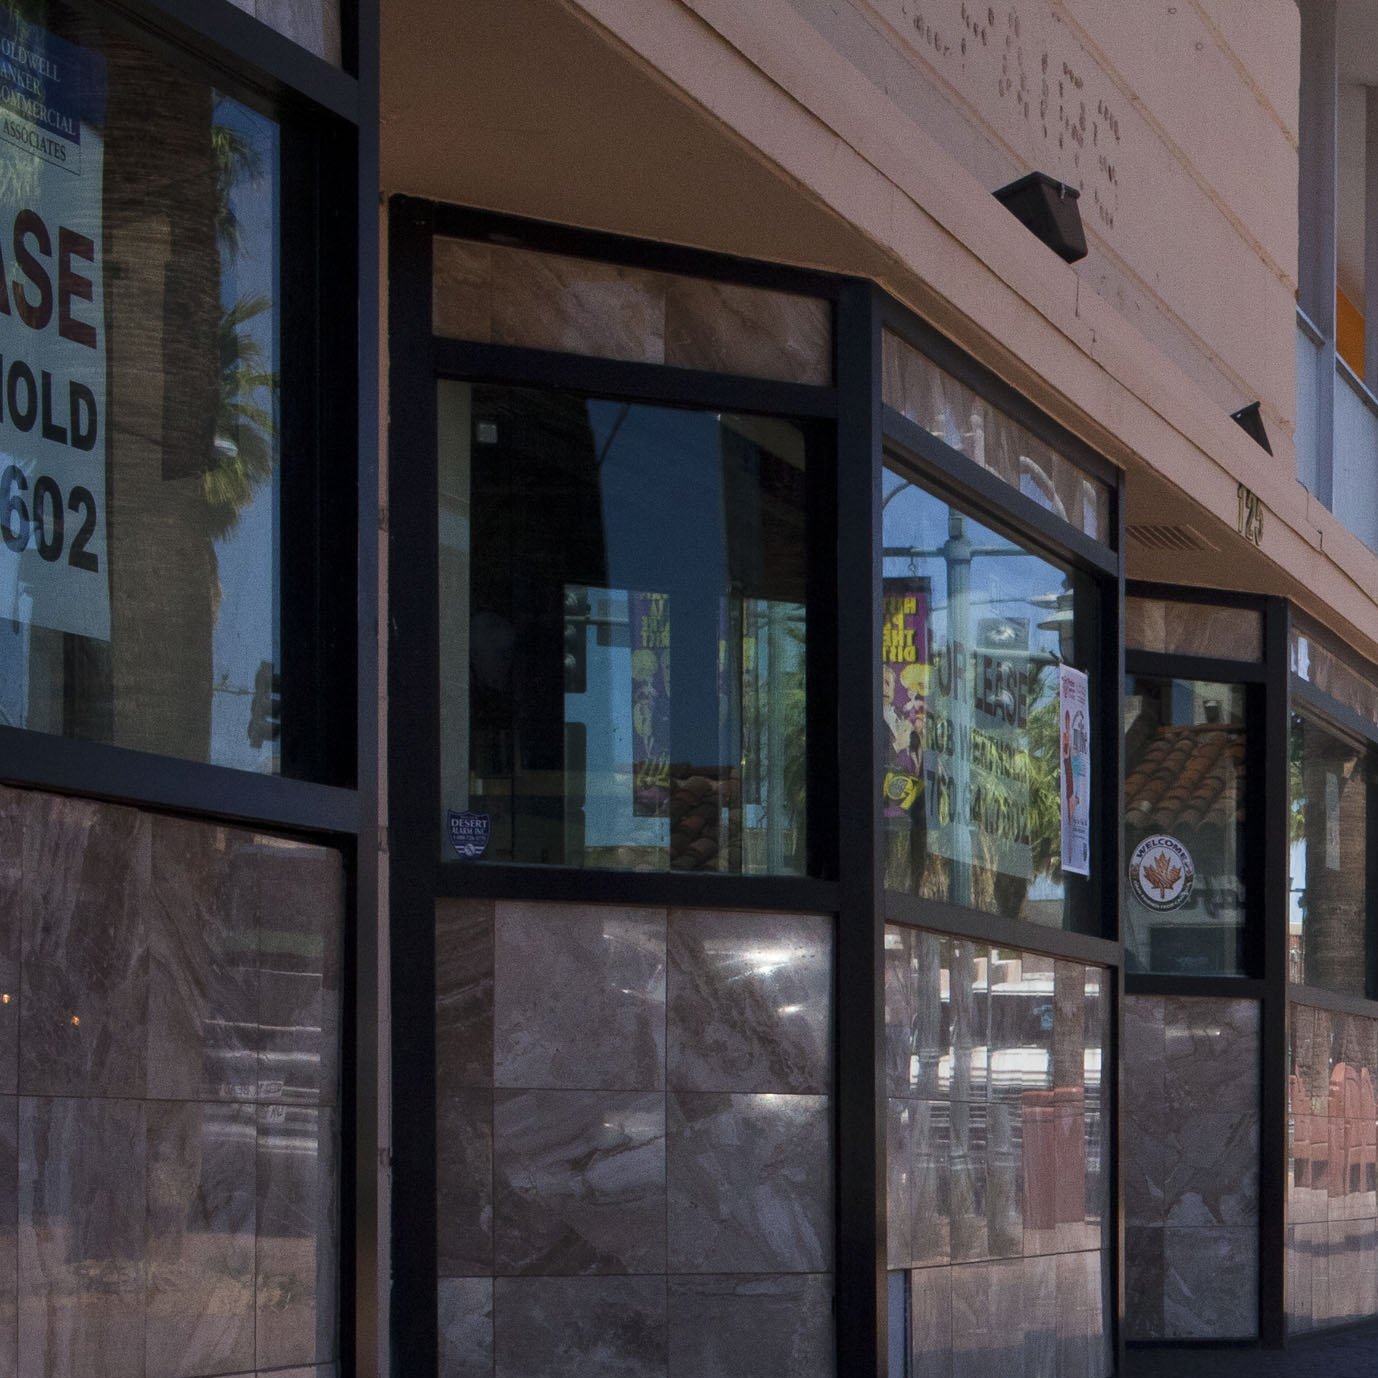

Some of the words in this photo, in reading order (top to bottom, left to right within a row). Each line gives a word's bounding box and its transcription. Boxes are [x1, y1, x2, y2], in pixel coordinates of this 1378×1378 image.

[3, 119, 67, 162] ASSOCIATES
[0, 354, 98, 452] OLD
[1236, 482, 1263, 547] 125
[451, 819, 488, 828] DESERT
[1136, 838, 1188, 862] WELCOME
